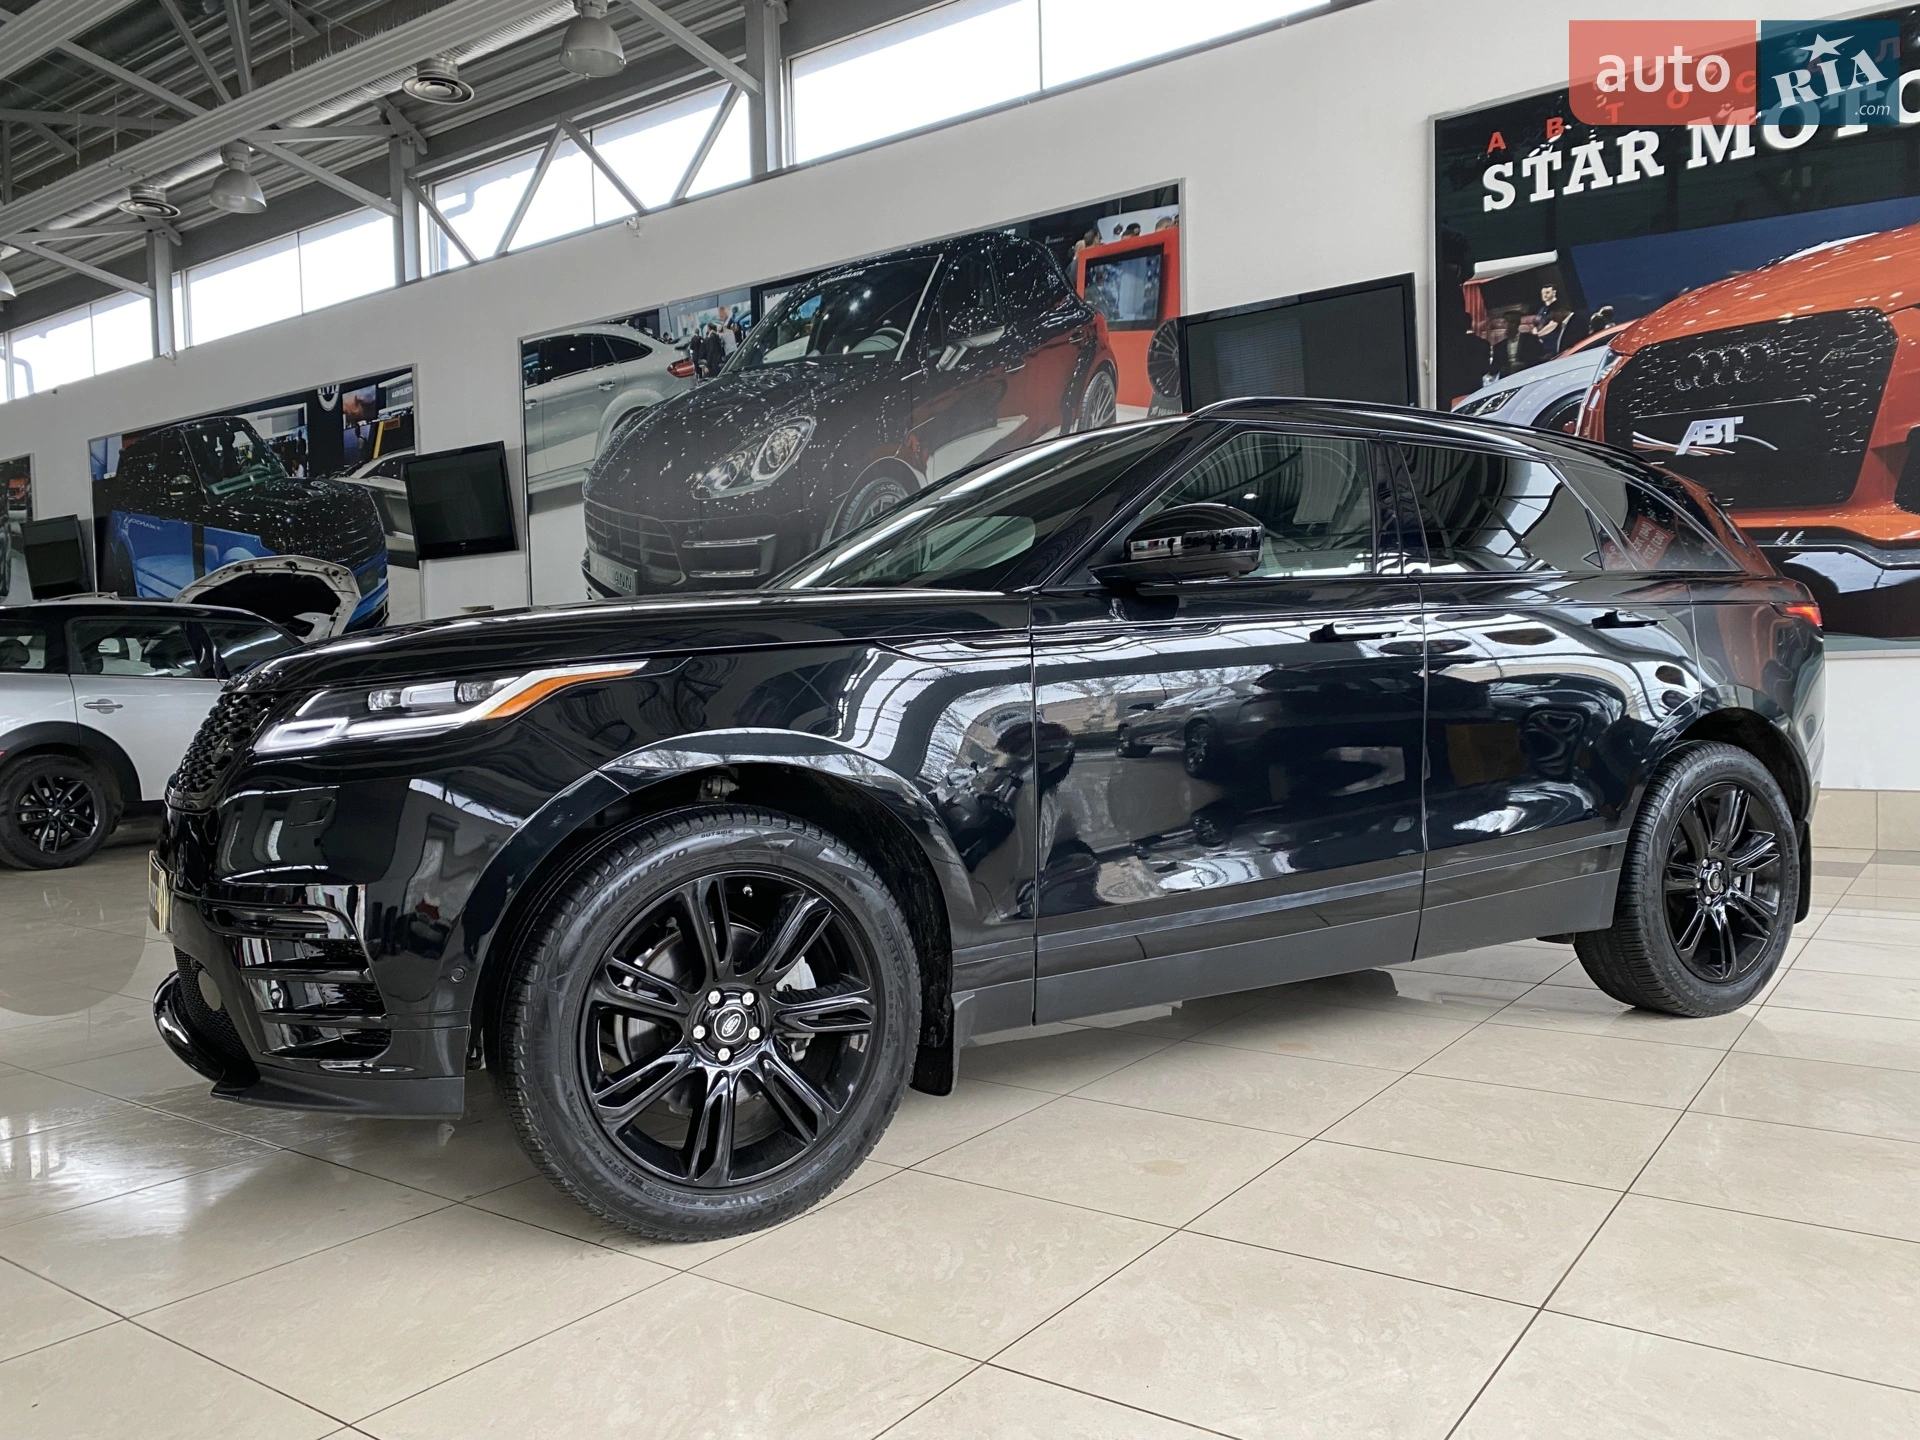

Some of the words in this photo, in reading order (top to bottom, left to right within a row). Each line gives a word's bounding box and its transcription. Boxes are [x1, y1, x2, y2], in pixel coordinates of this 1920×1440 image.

[1483, 130, 1665, 212] STAR
[1675, 416, 1744, 455] ABT
[700, 829, 734, 838] OUTSIDE
